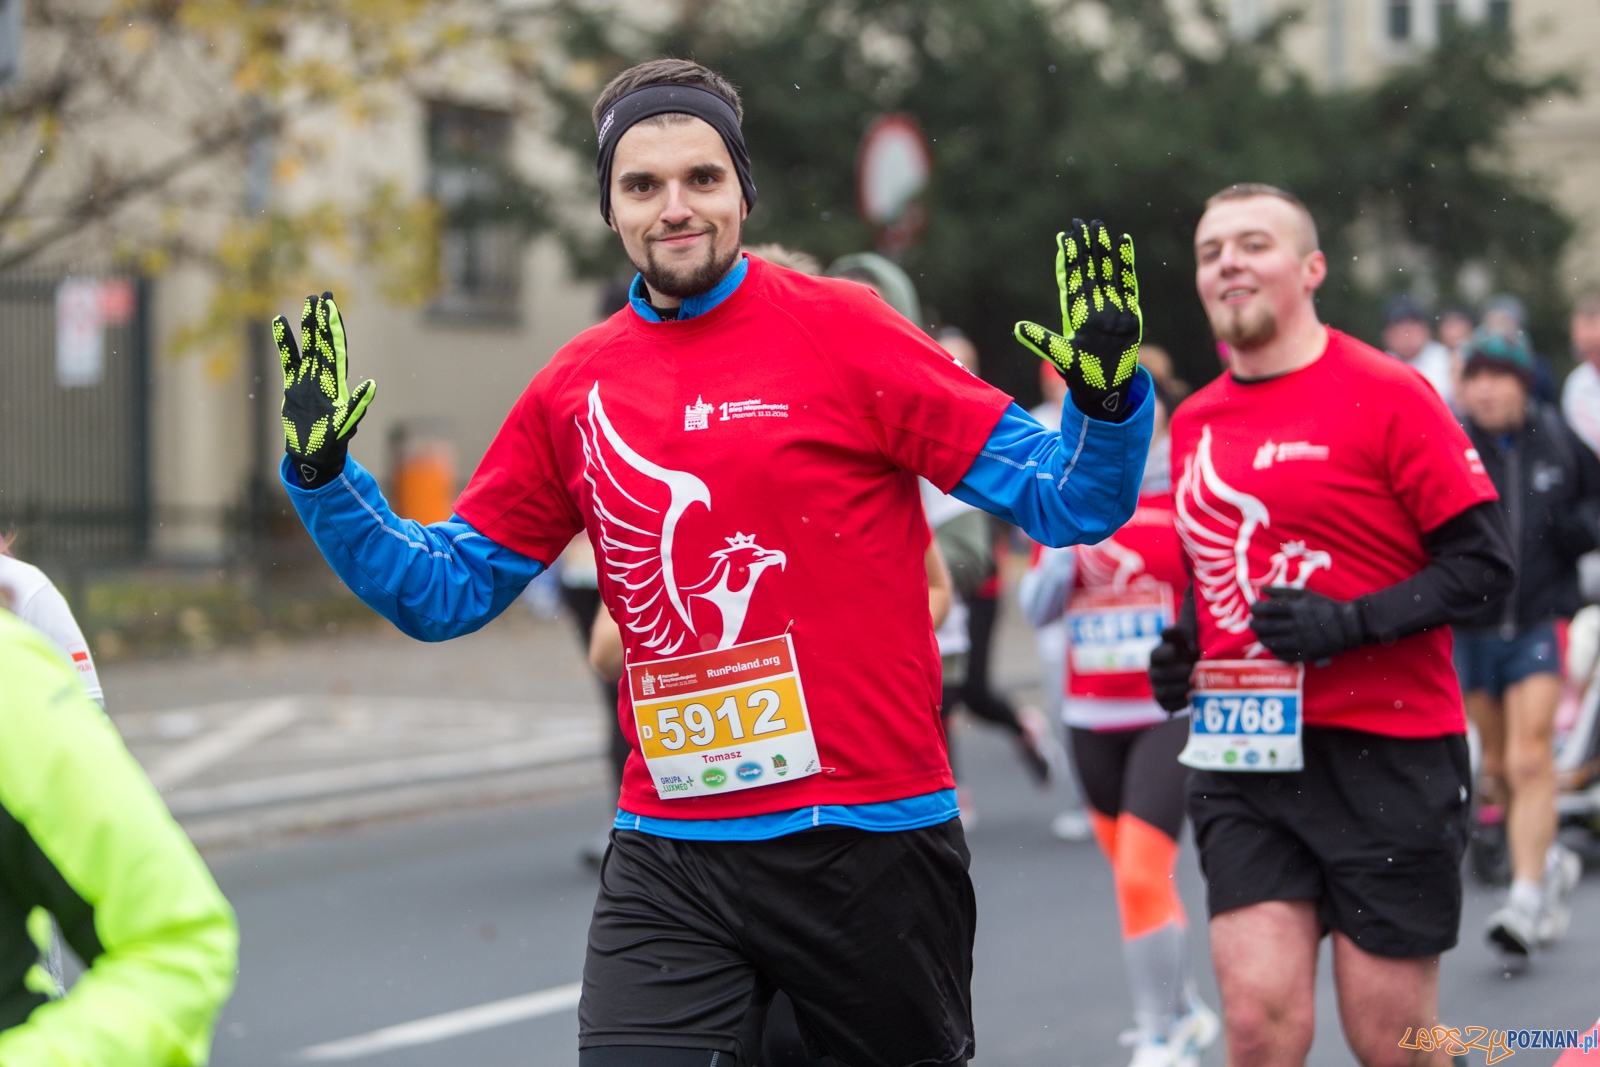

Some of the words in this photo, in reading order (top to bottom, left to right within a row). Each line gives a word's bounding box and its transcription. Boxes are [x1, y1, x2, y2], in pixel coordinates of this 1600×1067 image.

[718, 401, 730, 421] 1
[706, 655, 781, 679] RunPoland.org
[642, 725, 653, 740] D
[656, 689, 787, 750] 5912
[1203, 698, 1285, 734] 6768
[701, 750, 743, 764] Tomasz
[660, 776, 683, 785] GRUPA
